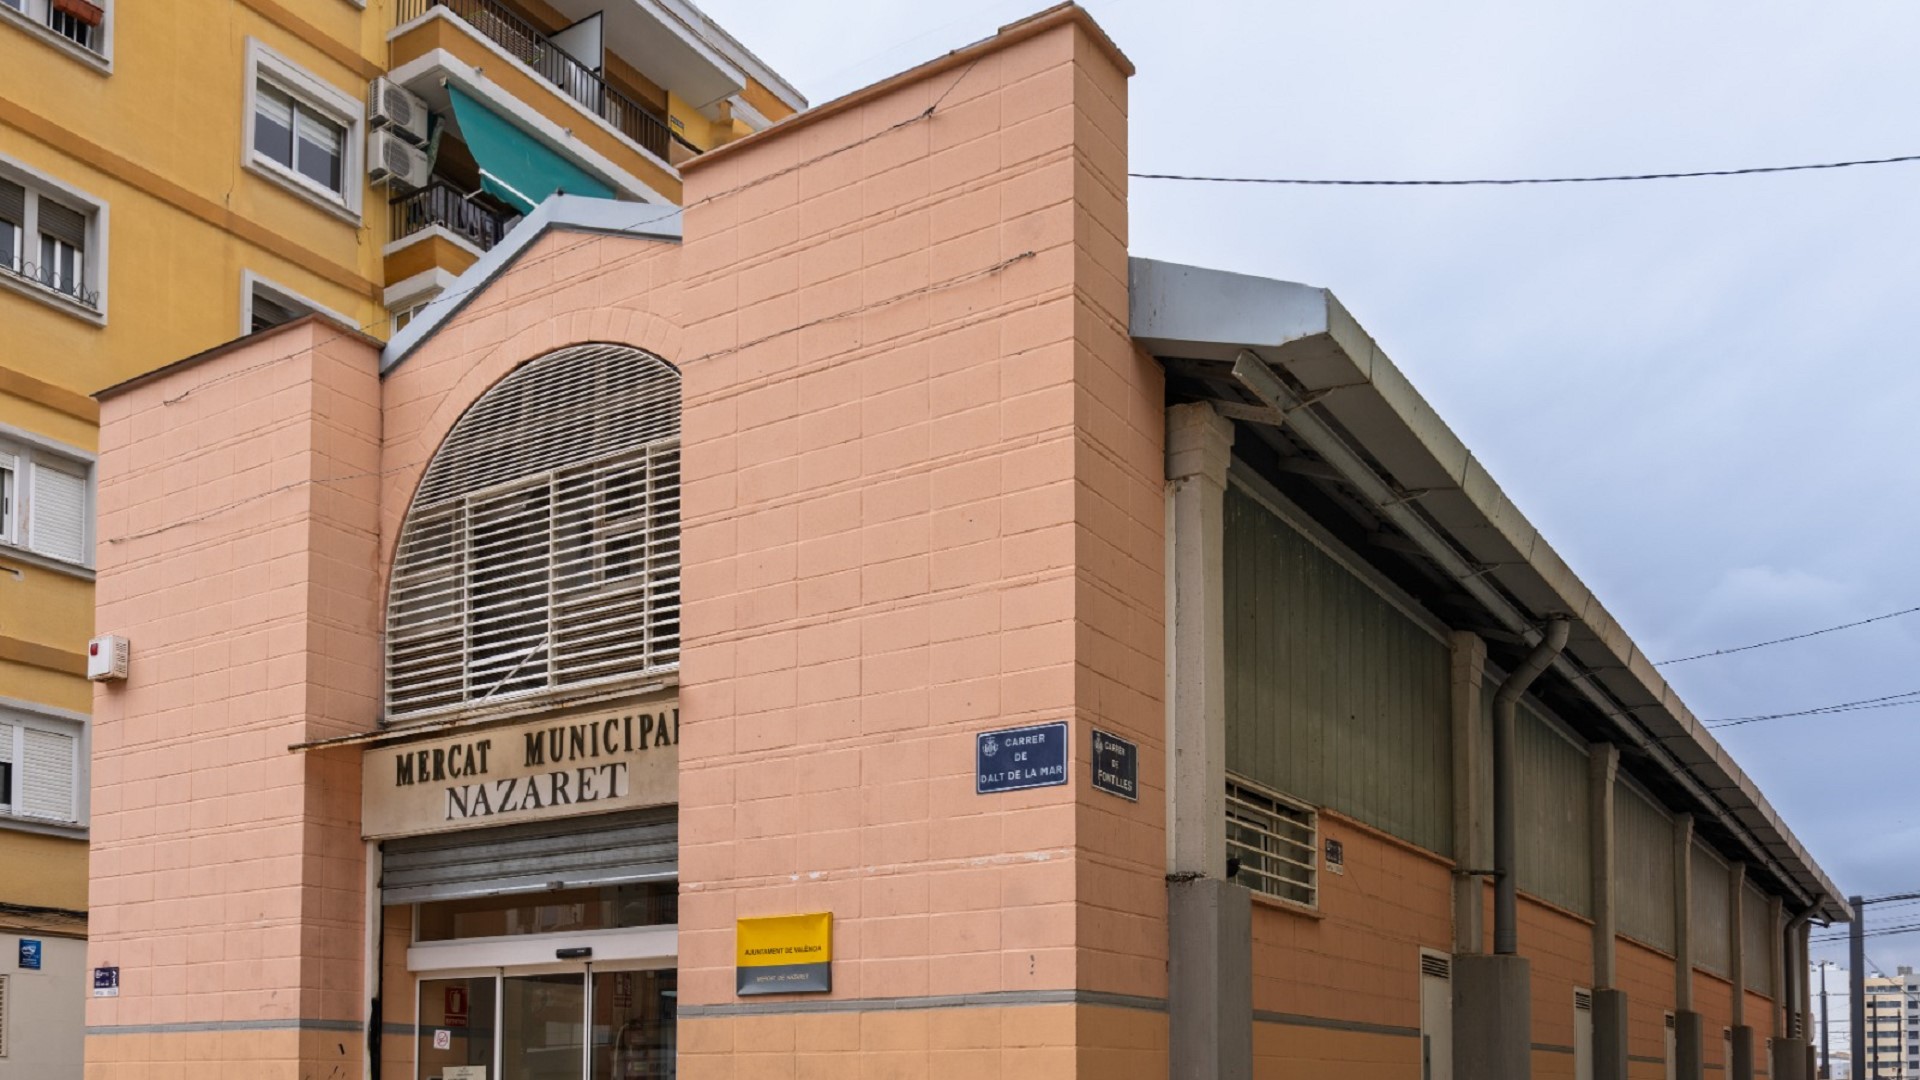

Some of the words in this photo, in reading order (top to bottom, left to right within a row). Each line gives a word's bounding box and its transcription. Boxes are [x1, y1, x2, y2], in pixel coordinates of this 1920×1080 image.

[1004, 733, 1046, 748] CARRER
[396, 739, 491, 787] MERCAT
[1014, 751, 1028, 762] DE
[980, 772, 1004, 784] DALT
[1007, 770, 1021, 781] DE
[1024, 768, 1037, 779] LA
[1039, 765, 1063, 776] MAR
[446, 762, 627, 821] NAZARET
[784, 946, 793, 954] DE
